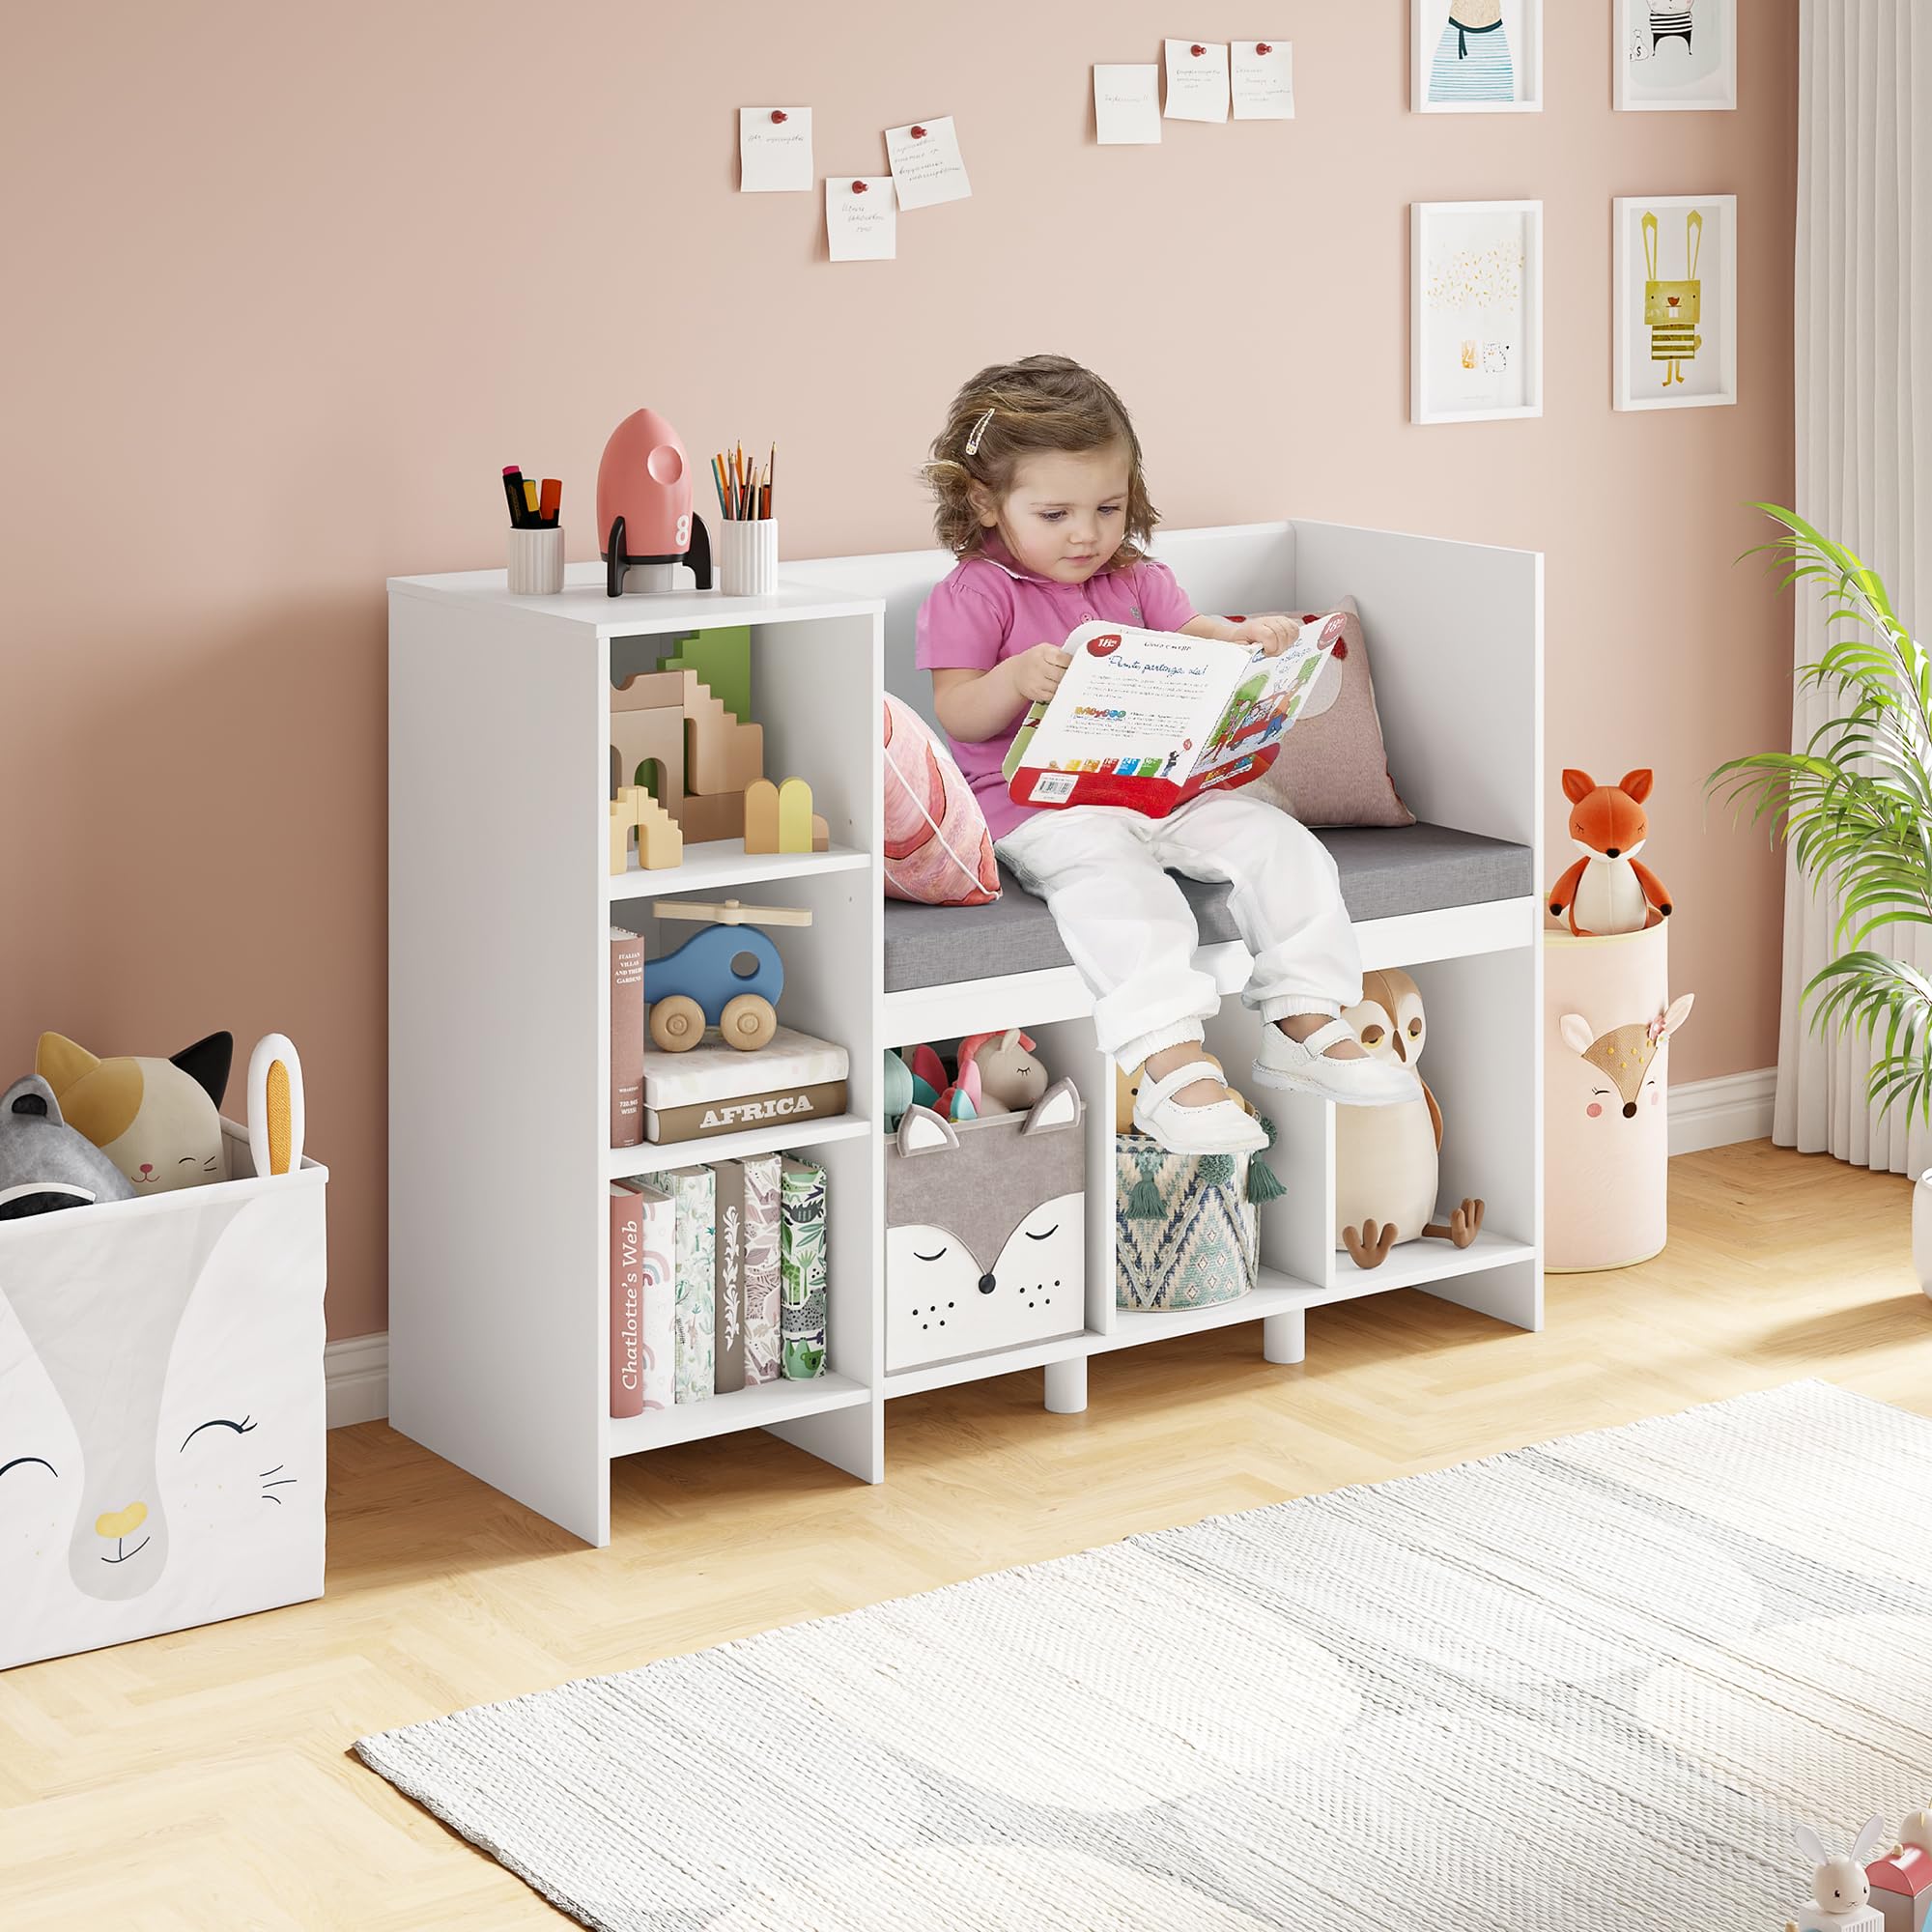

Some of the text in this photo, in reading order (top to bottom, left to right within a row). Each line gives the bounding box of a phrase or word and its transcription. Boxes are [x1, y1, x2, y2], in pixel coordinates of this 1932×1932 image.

[675, 514, 690, 547] 8
[618, 952, 640, 960] ITALIAN
[699, 1094, 813, 1128] AFRICA
[621, 1219, 639, 1268] Web
